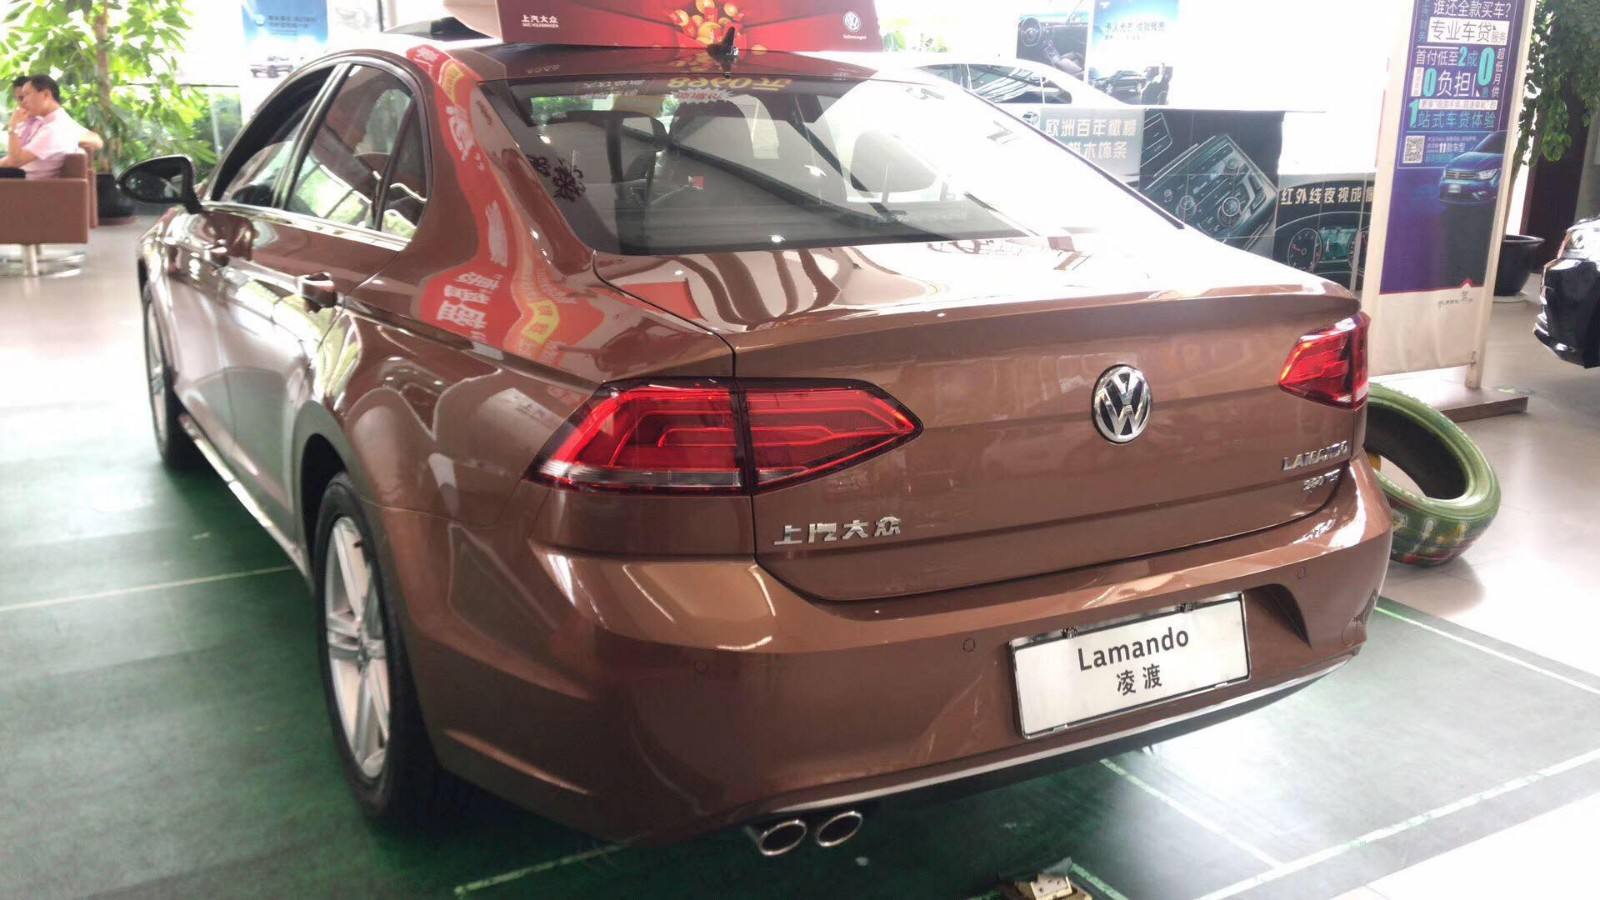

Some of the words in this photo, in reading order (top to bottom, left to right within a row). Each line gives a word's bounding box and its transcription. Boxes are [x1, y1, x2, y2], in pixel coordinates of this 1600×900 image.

[521, 14, 559, 24] 上汽大众
[1431, 20, 1491, 42] 专业车贷
[774, 516, 901, 546] 上汽大众
[1077, 626, 1189, 671] Lamando
[1117, 664, 1162, 696] 凌渡
